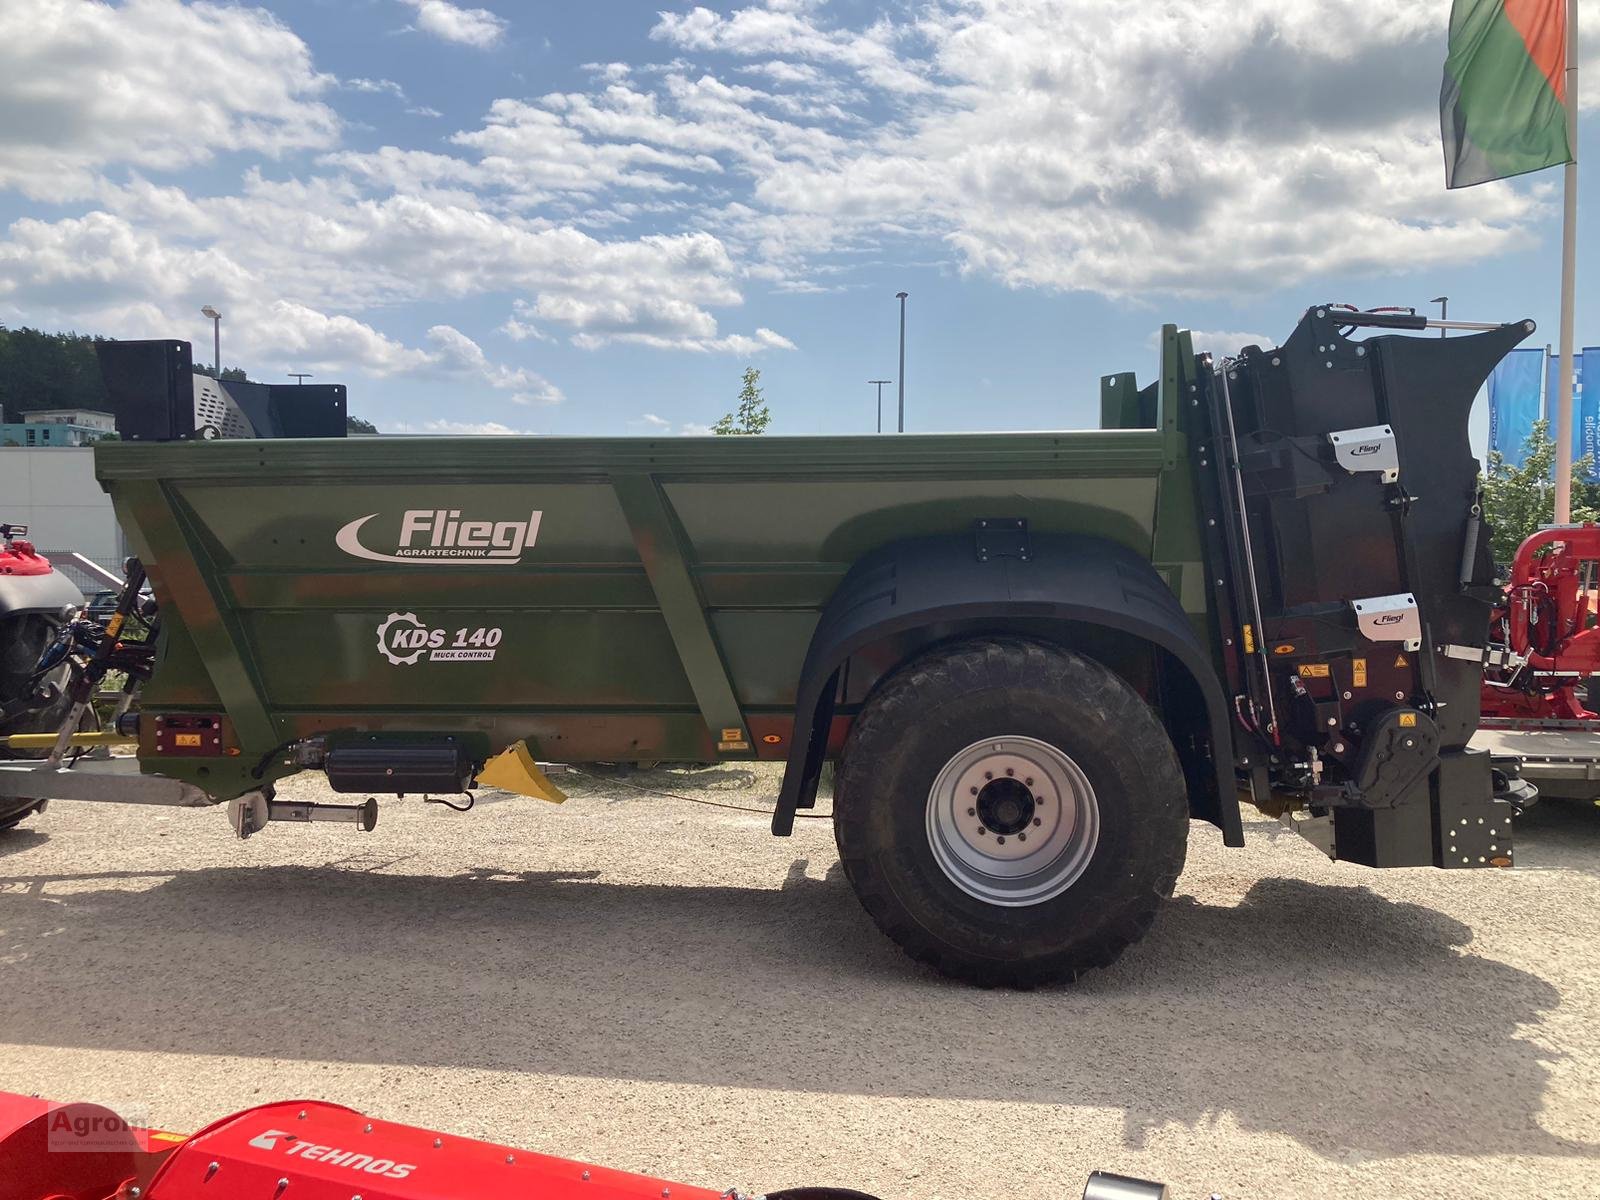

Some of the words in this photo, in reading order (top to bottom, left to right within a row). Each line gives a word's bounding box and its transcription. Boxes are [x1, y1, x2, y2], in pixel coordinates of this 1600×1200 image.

[398, 510, 543, 557] Fliegl
[395, 549, 487, 557] AGRARTECHNIK
[1381, 613, 1404, 623] Fliegl
[391, 628, 446, 649] KDS
[451, 627, 503, 648] 140
[433, 651, 455, 659] MUCK
[457, 651, 492, 659] CONTROL
[285, 1140, 417, 1179] TEHNOS
